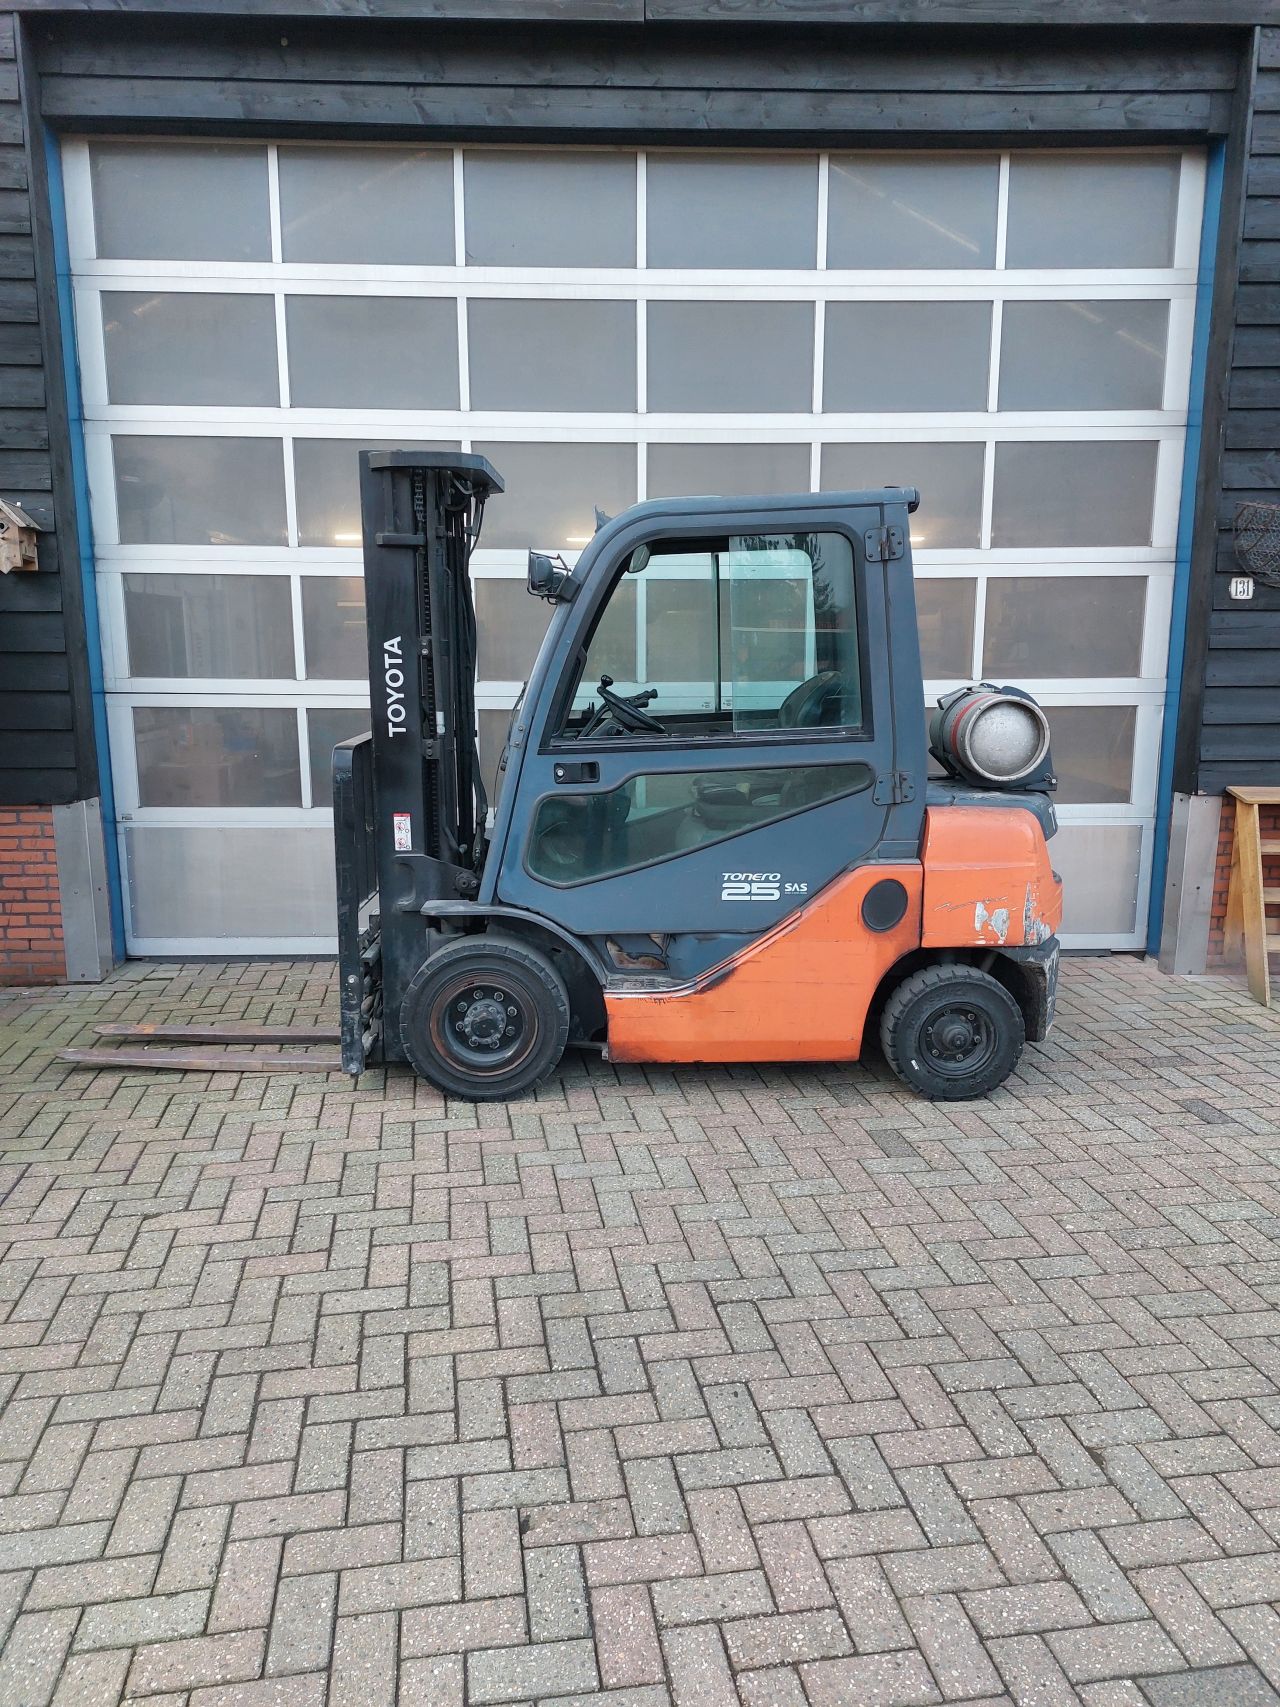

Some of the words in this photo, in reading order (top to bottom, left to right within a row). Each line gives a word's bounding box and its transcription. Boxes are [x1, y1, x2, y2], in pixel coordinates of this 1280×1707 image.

[1234, 579, 1250, 597] 131
[383, 635, 407, 738] TOYOTA
[721, 872, 781, 881] TONERO
[721, 882, 781, 901] 25
[784, 882, 808, 892] SAS
